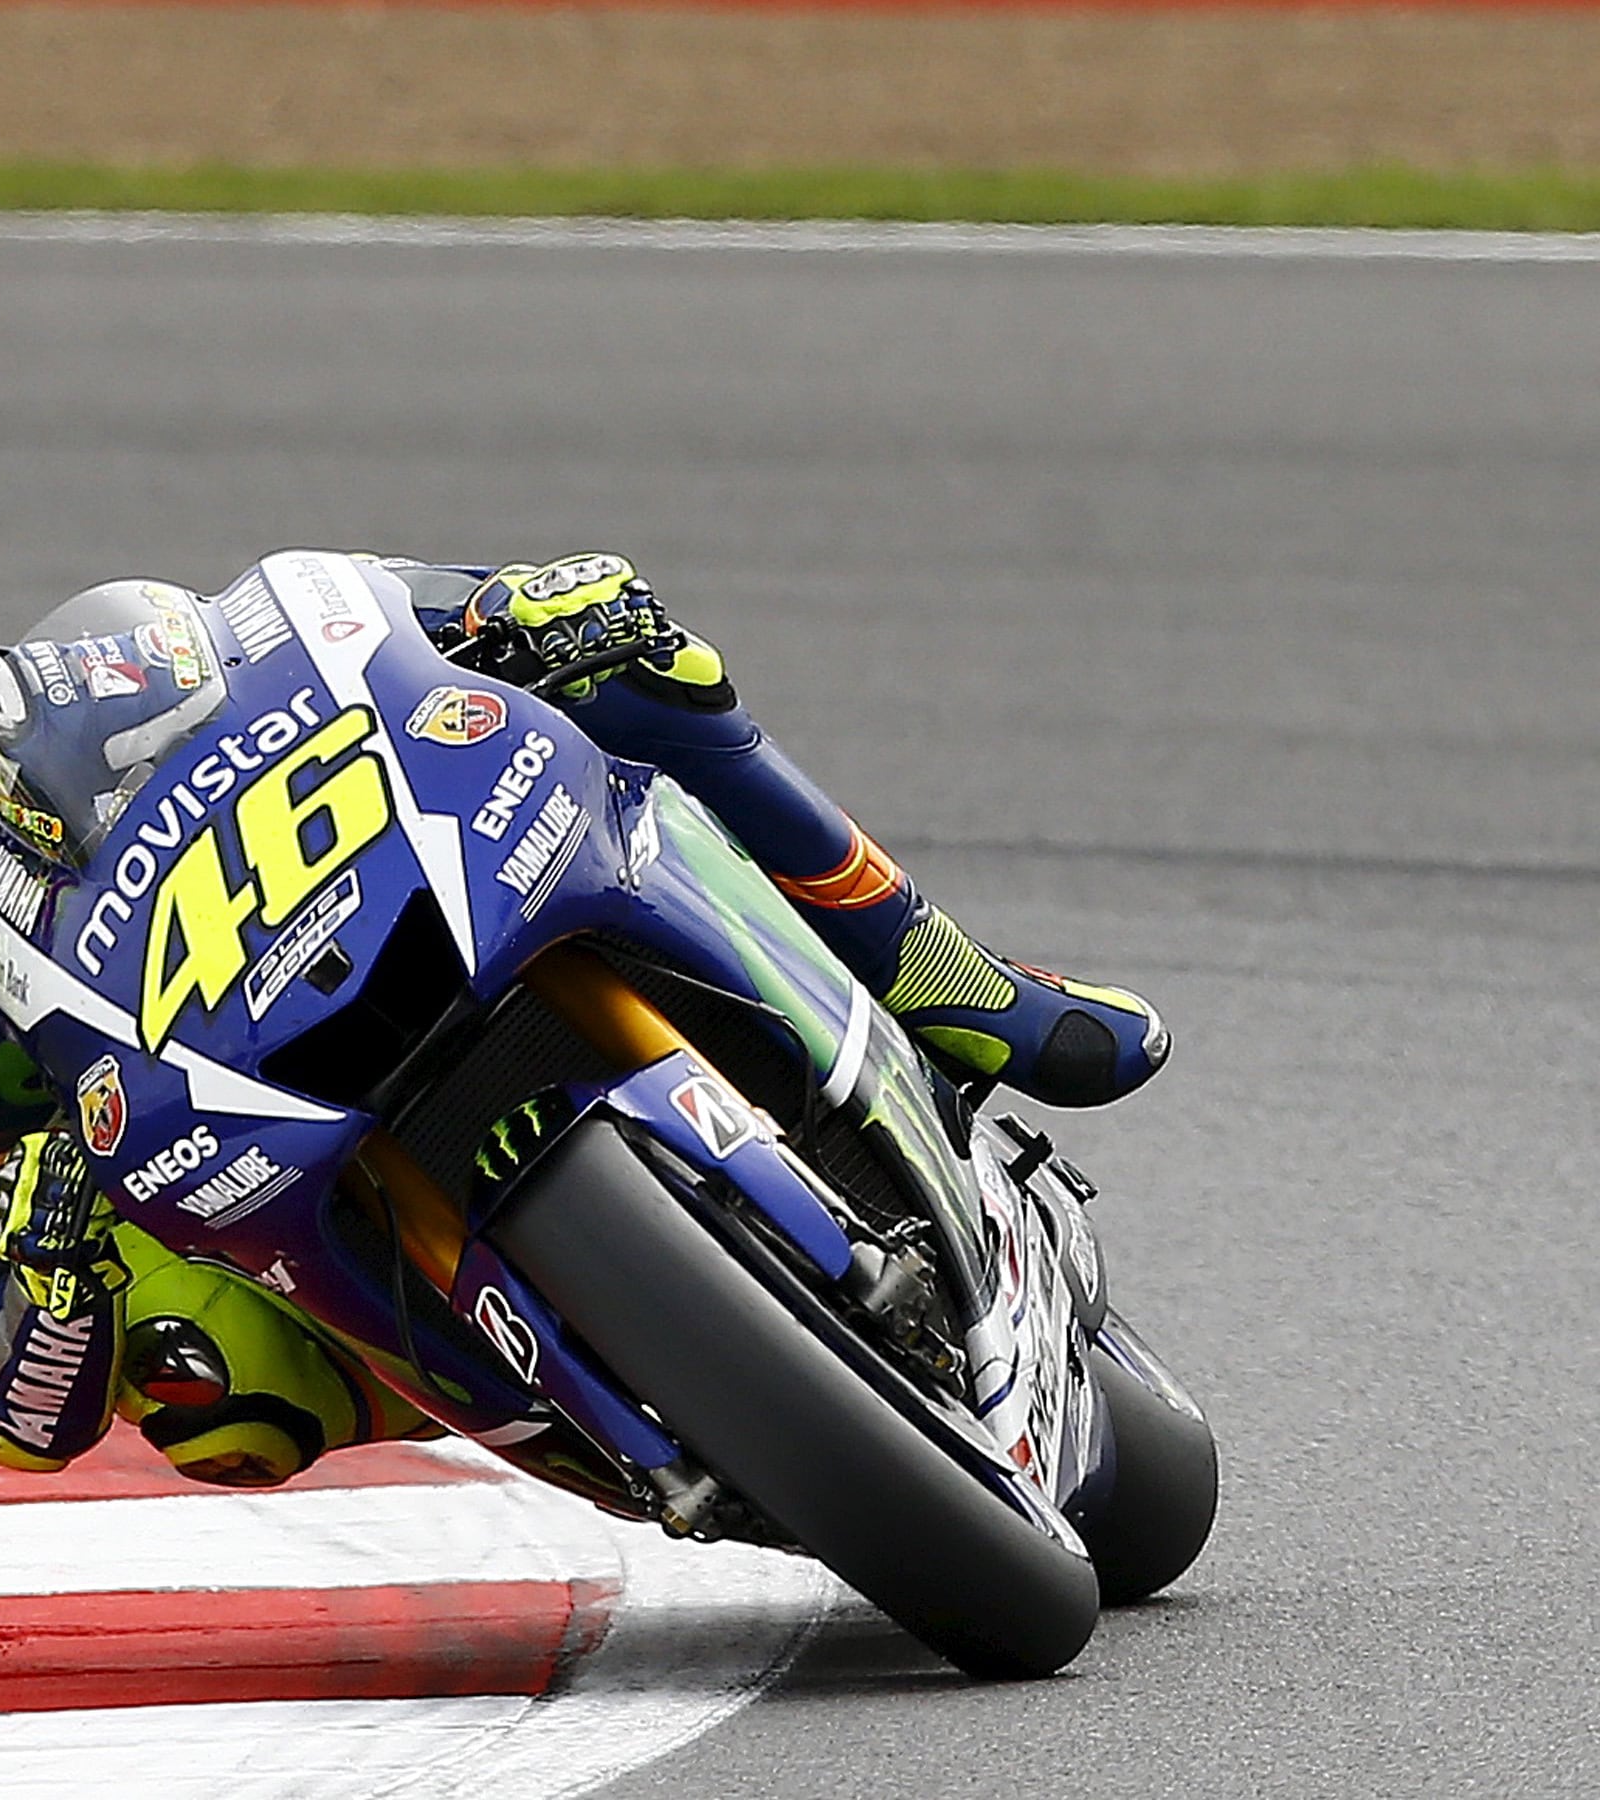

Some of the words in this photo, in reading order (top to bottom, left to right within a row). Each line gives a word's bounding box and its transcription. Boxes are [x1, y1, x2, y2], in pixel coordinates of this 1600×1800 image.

[76, 687, 322, 976] movistar
[473, 730, 557, 842] ENEOS
[497, 783, 580, 896] YAMALUBE
[140, 708, 393, 1053] 46
[122, 1124, 220, 1203] ENEOS
[176, 1145, 281, 1219] YAMALUBE
